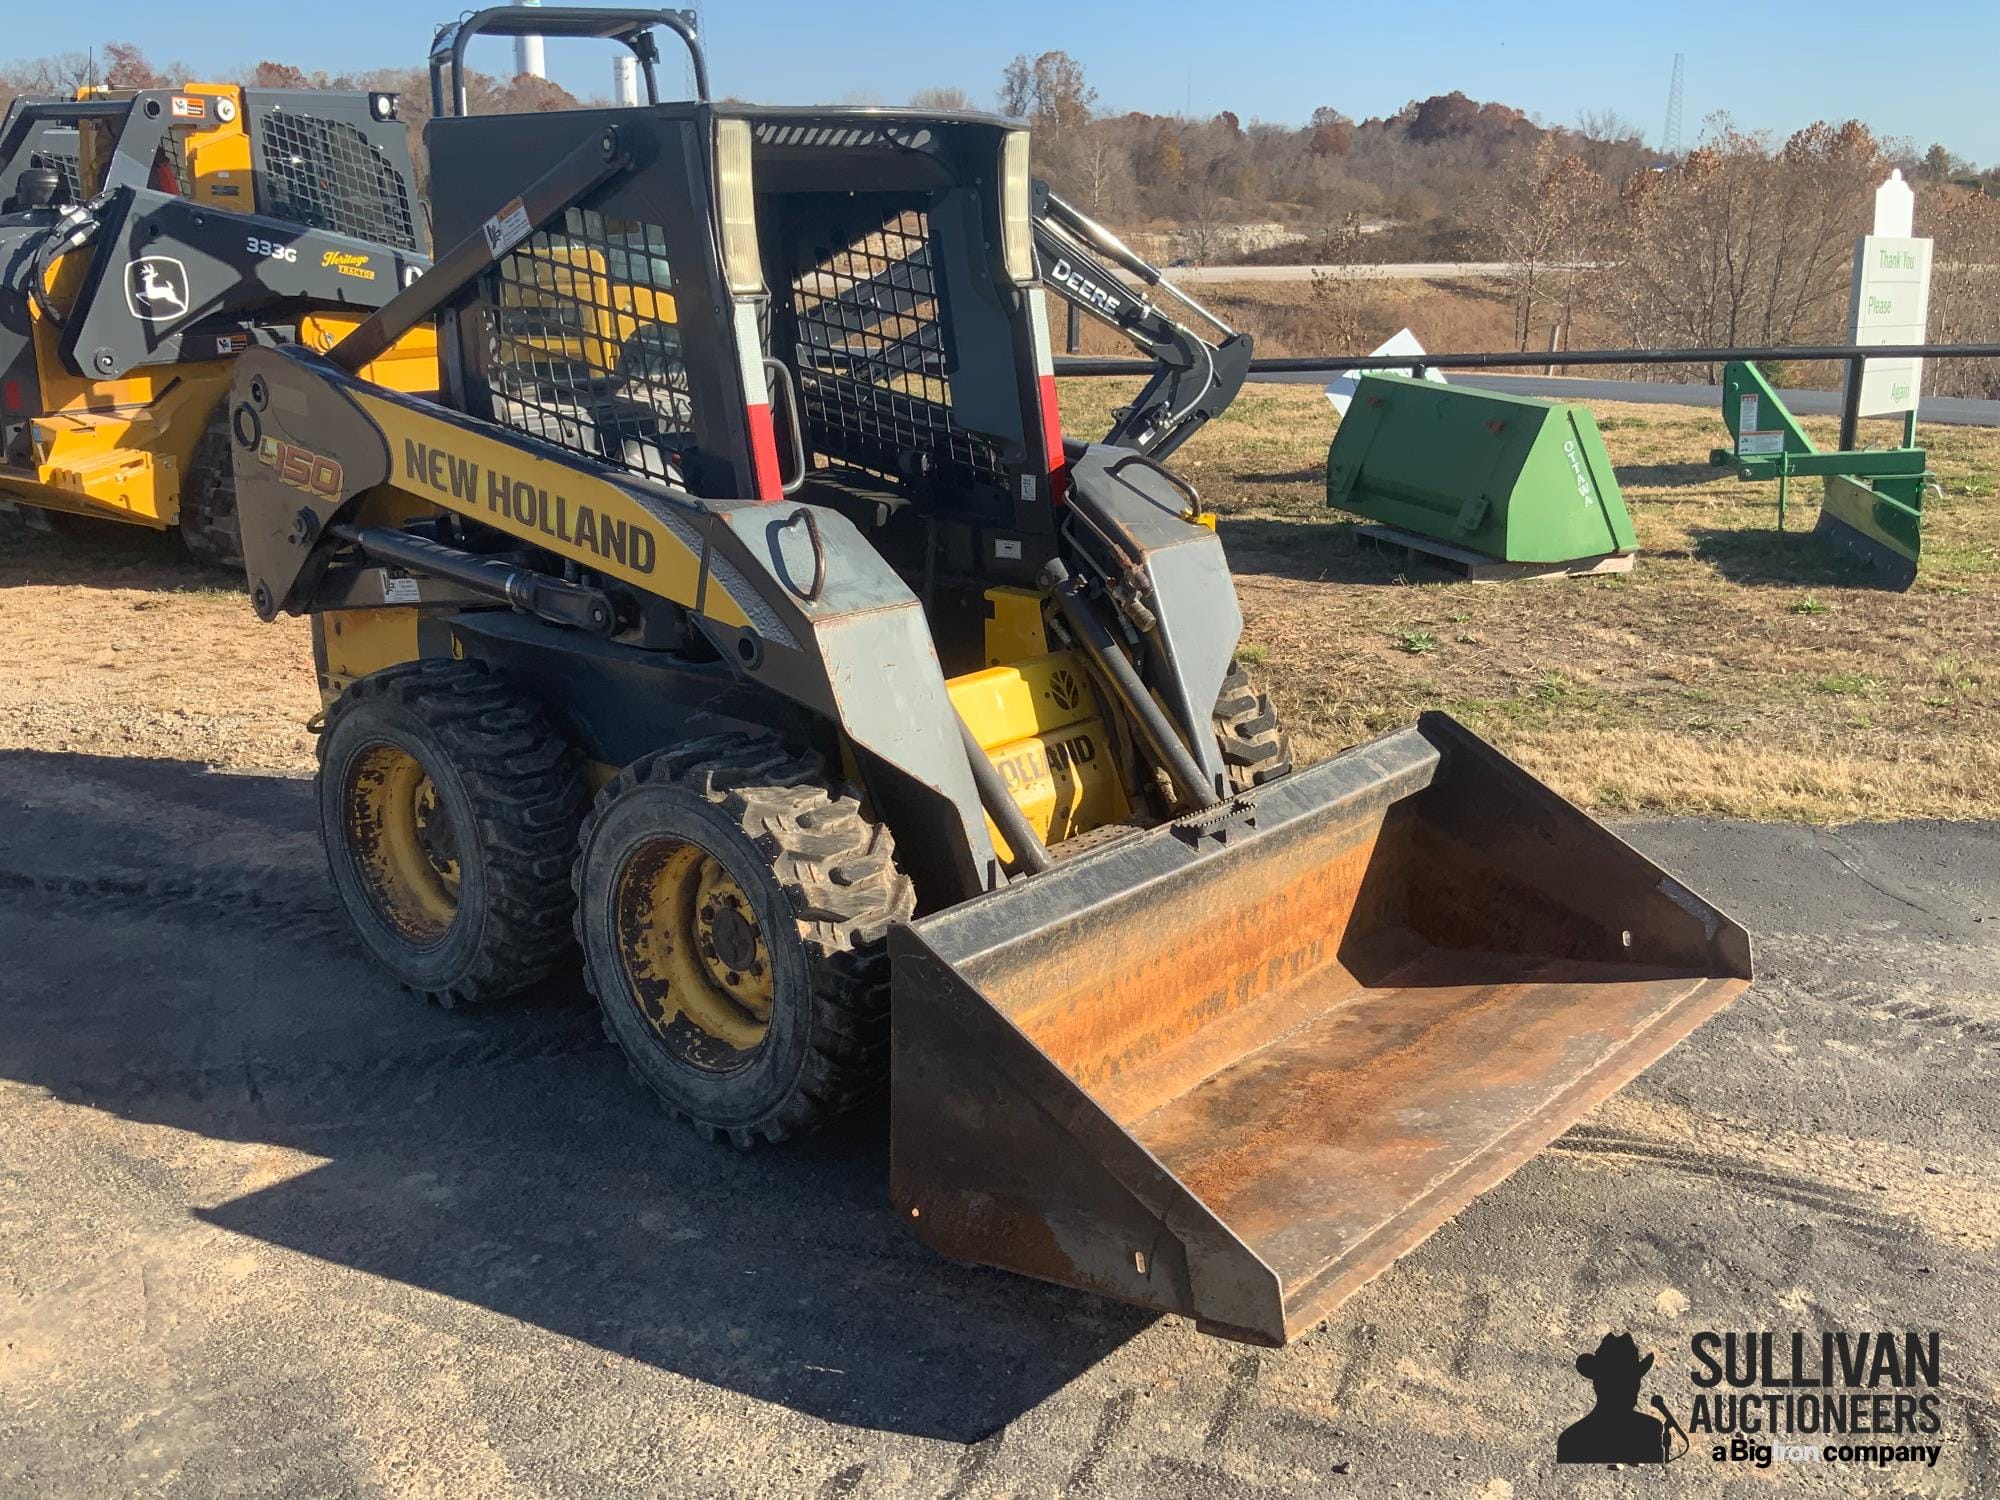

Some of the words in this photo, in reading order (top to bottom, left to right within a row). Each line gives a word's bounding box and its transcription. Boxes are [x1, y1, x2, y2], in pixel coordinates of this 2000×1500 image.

[246, 237, 297, 263] 333G
[321, 251, 369, 267] Heritage
[1879, 250, 1901, 270] Thank
[1903, 251, 1914, 270] You
[1051, 258, 1121, 315] DEERE
[1868, 296, 1892, 314] Please
[1891, 382, 1910, 403] Again
[1564, 440, 1592, 508] OTTAWA
[405, 438, 478, 504] NEW
[487, 468, 656, 576] HOLLAND
[996, 734, 1096, 789] OLLAND
